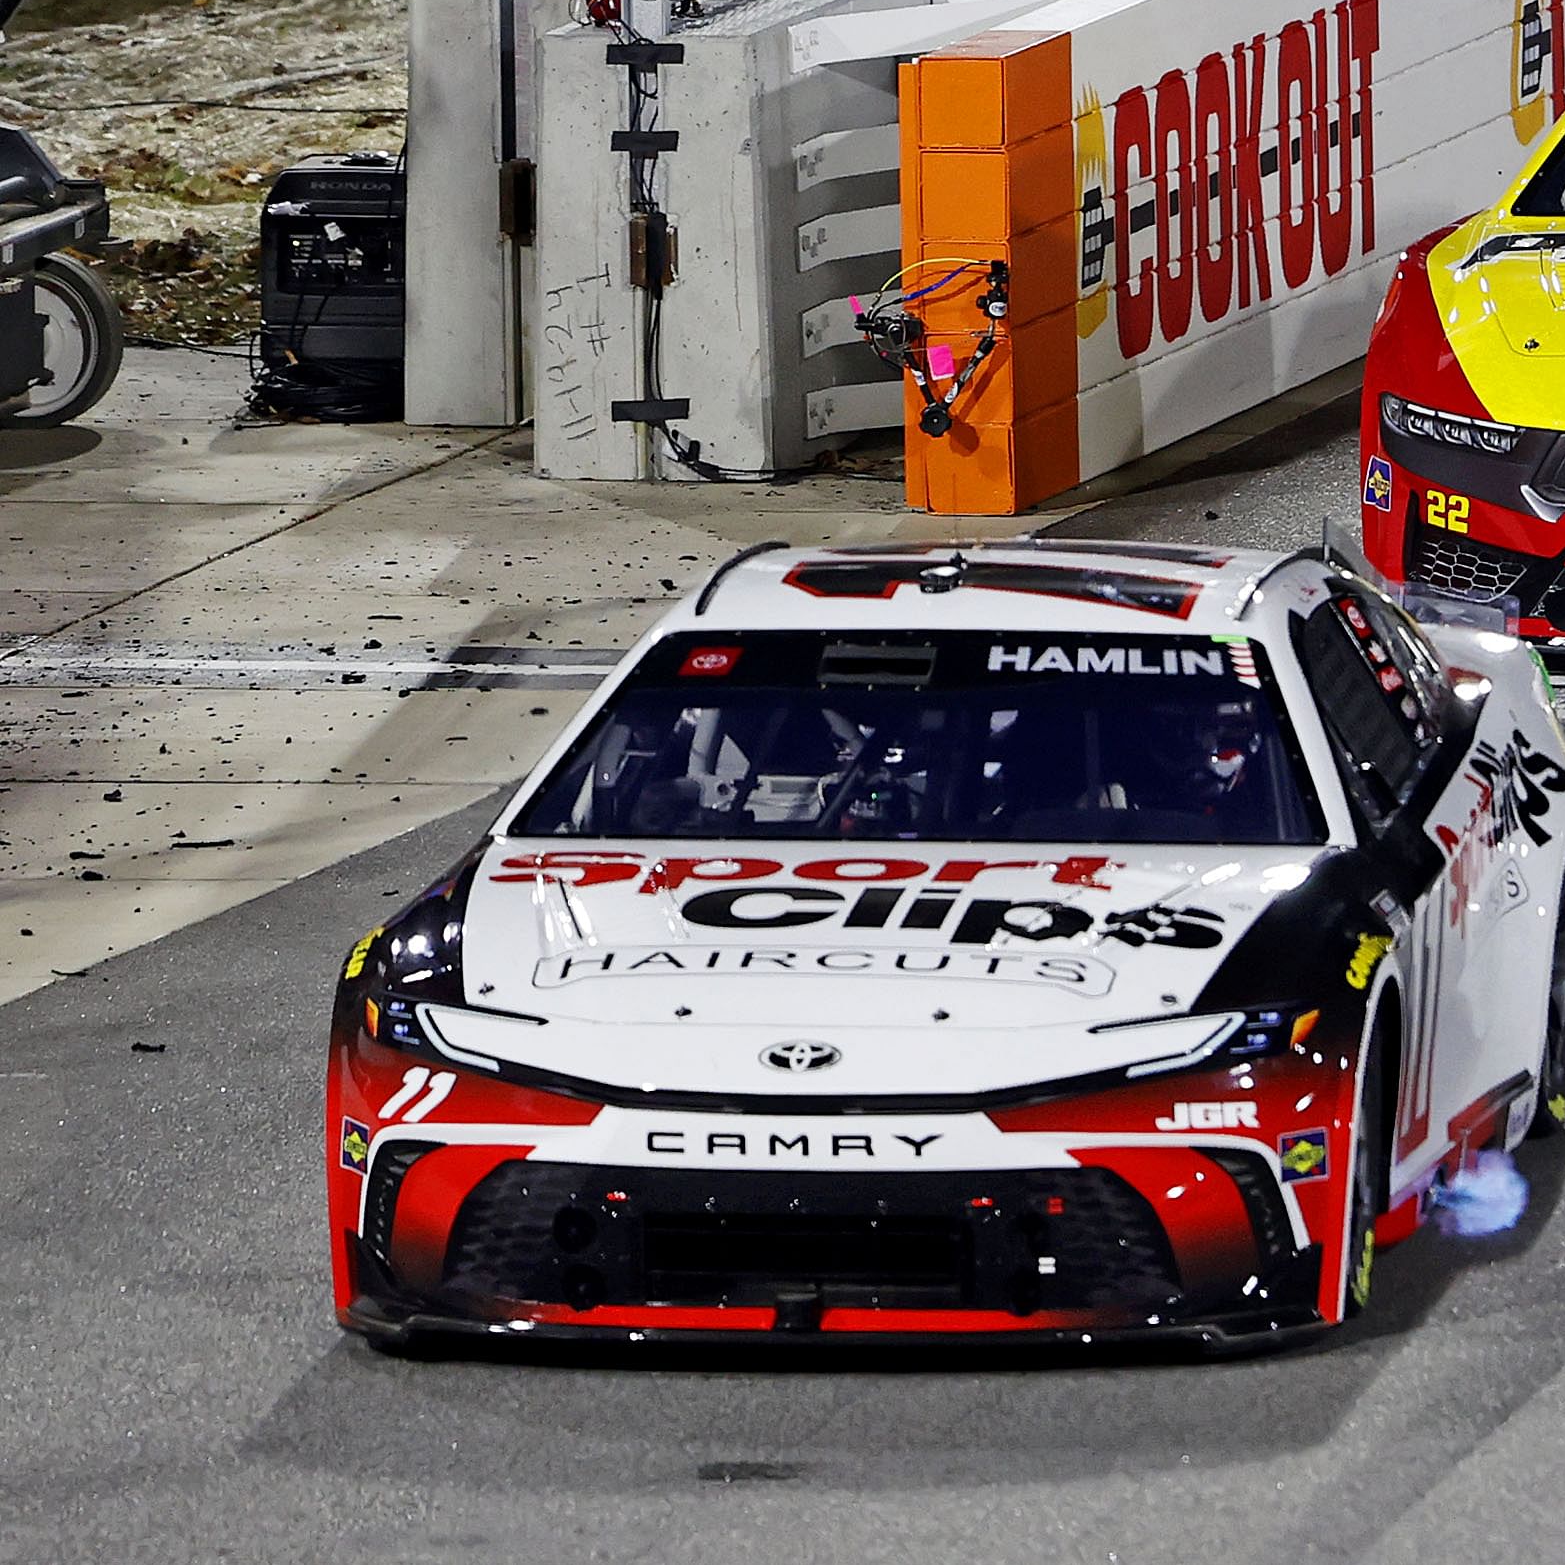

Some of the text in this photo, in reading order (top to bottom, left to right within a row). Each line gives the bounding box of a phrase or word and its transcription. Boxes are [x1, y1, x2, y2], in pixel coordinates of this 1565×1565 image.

[309, 181, 392, 191] HONDA
[1113, 33, 1273, 359] COOK
[1426, 489, 1470, 534] 22
[987, 646, 1225, 676] HAMLIN
[559, 947, 1088, 984] HAIRCUTS
[377, 1065, 458, 1123] 11
[1154, 1101, 1260, 1130] JGR
[646, 1132, 944, 1157] CAMRY
